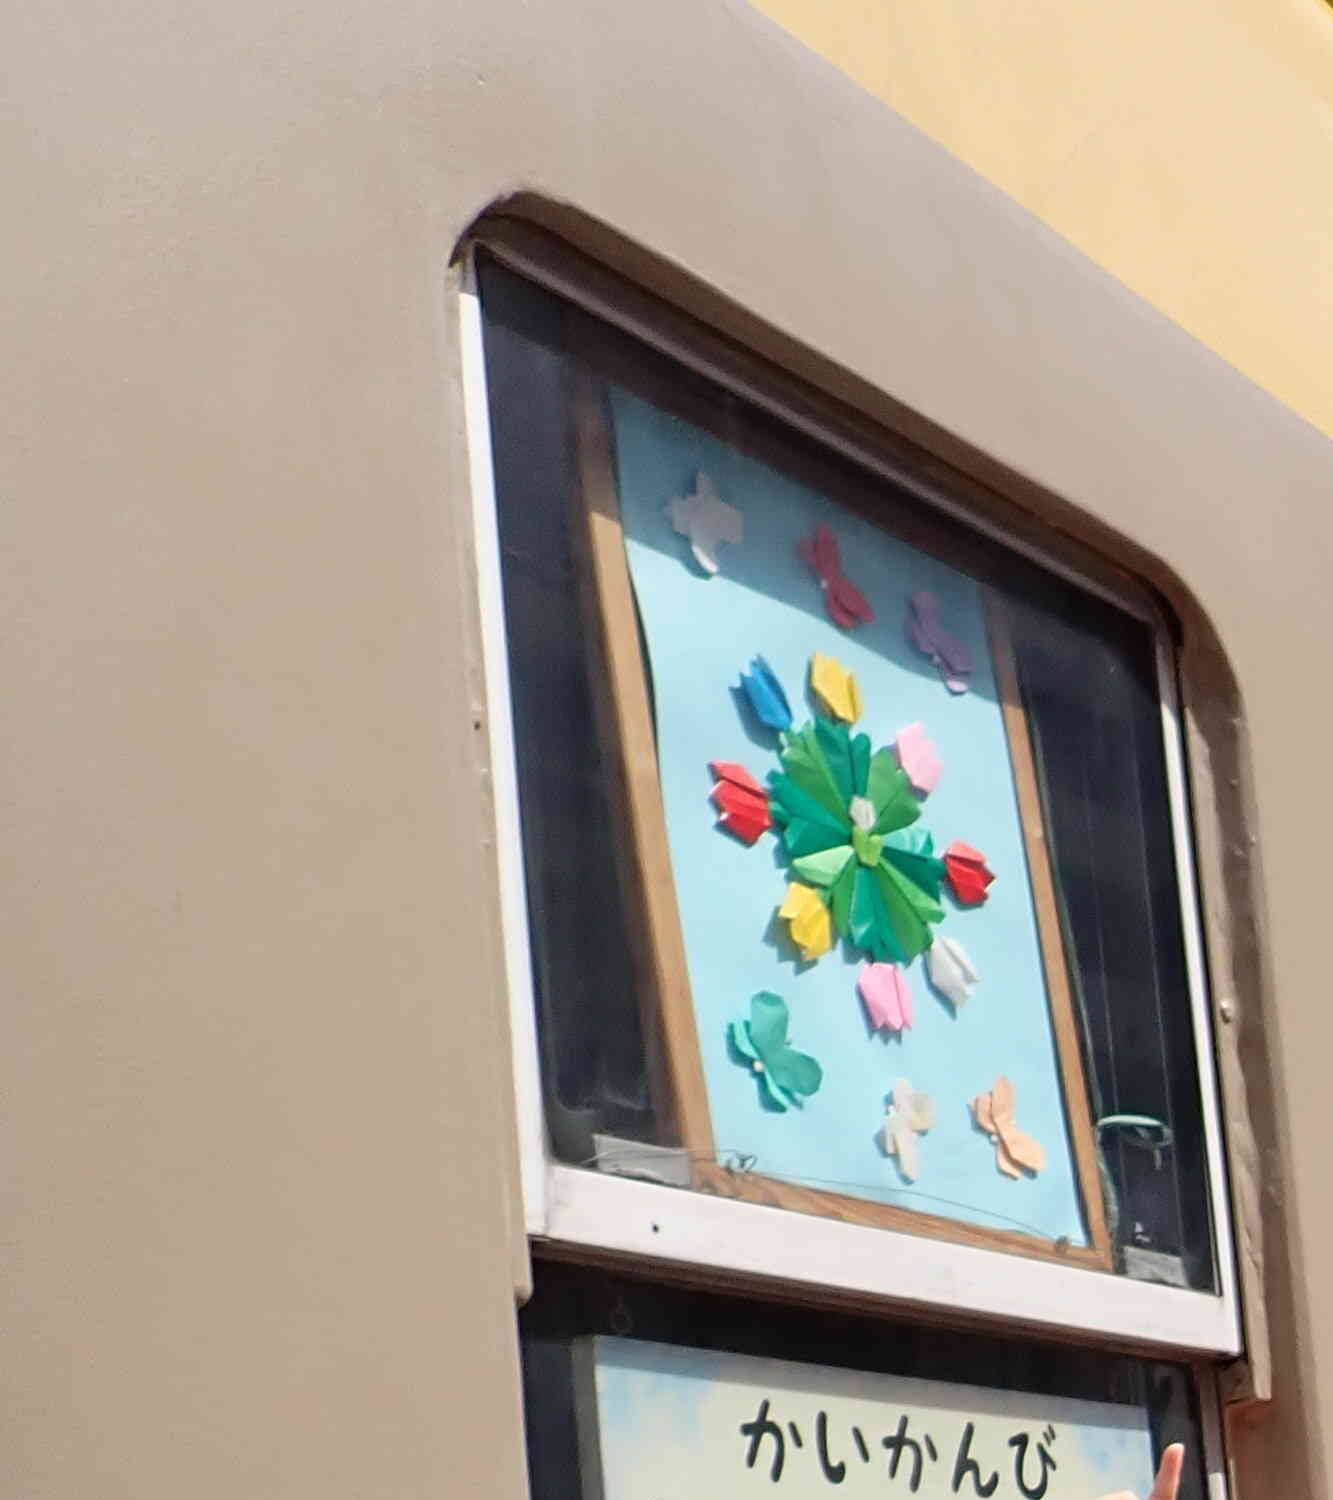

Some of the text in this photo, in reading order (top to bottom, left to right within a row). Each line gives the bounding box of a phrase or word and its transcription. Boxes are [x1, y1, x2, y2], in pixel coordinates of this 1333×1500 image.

[741, 1399, 1056, 1500] かいかんび
